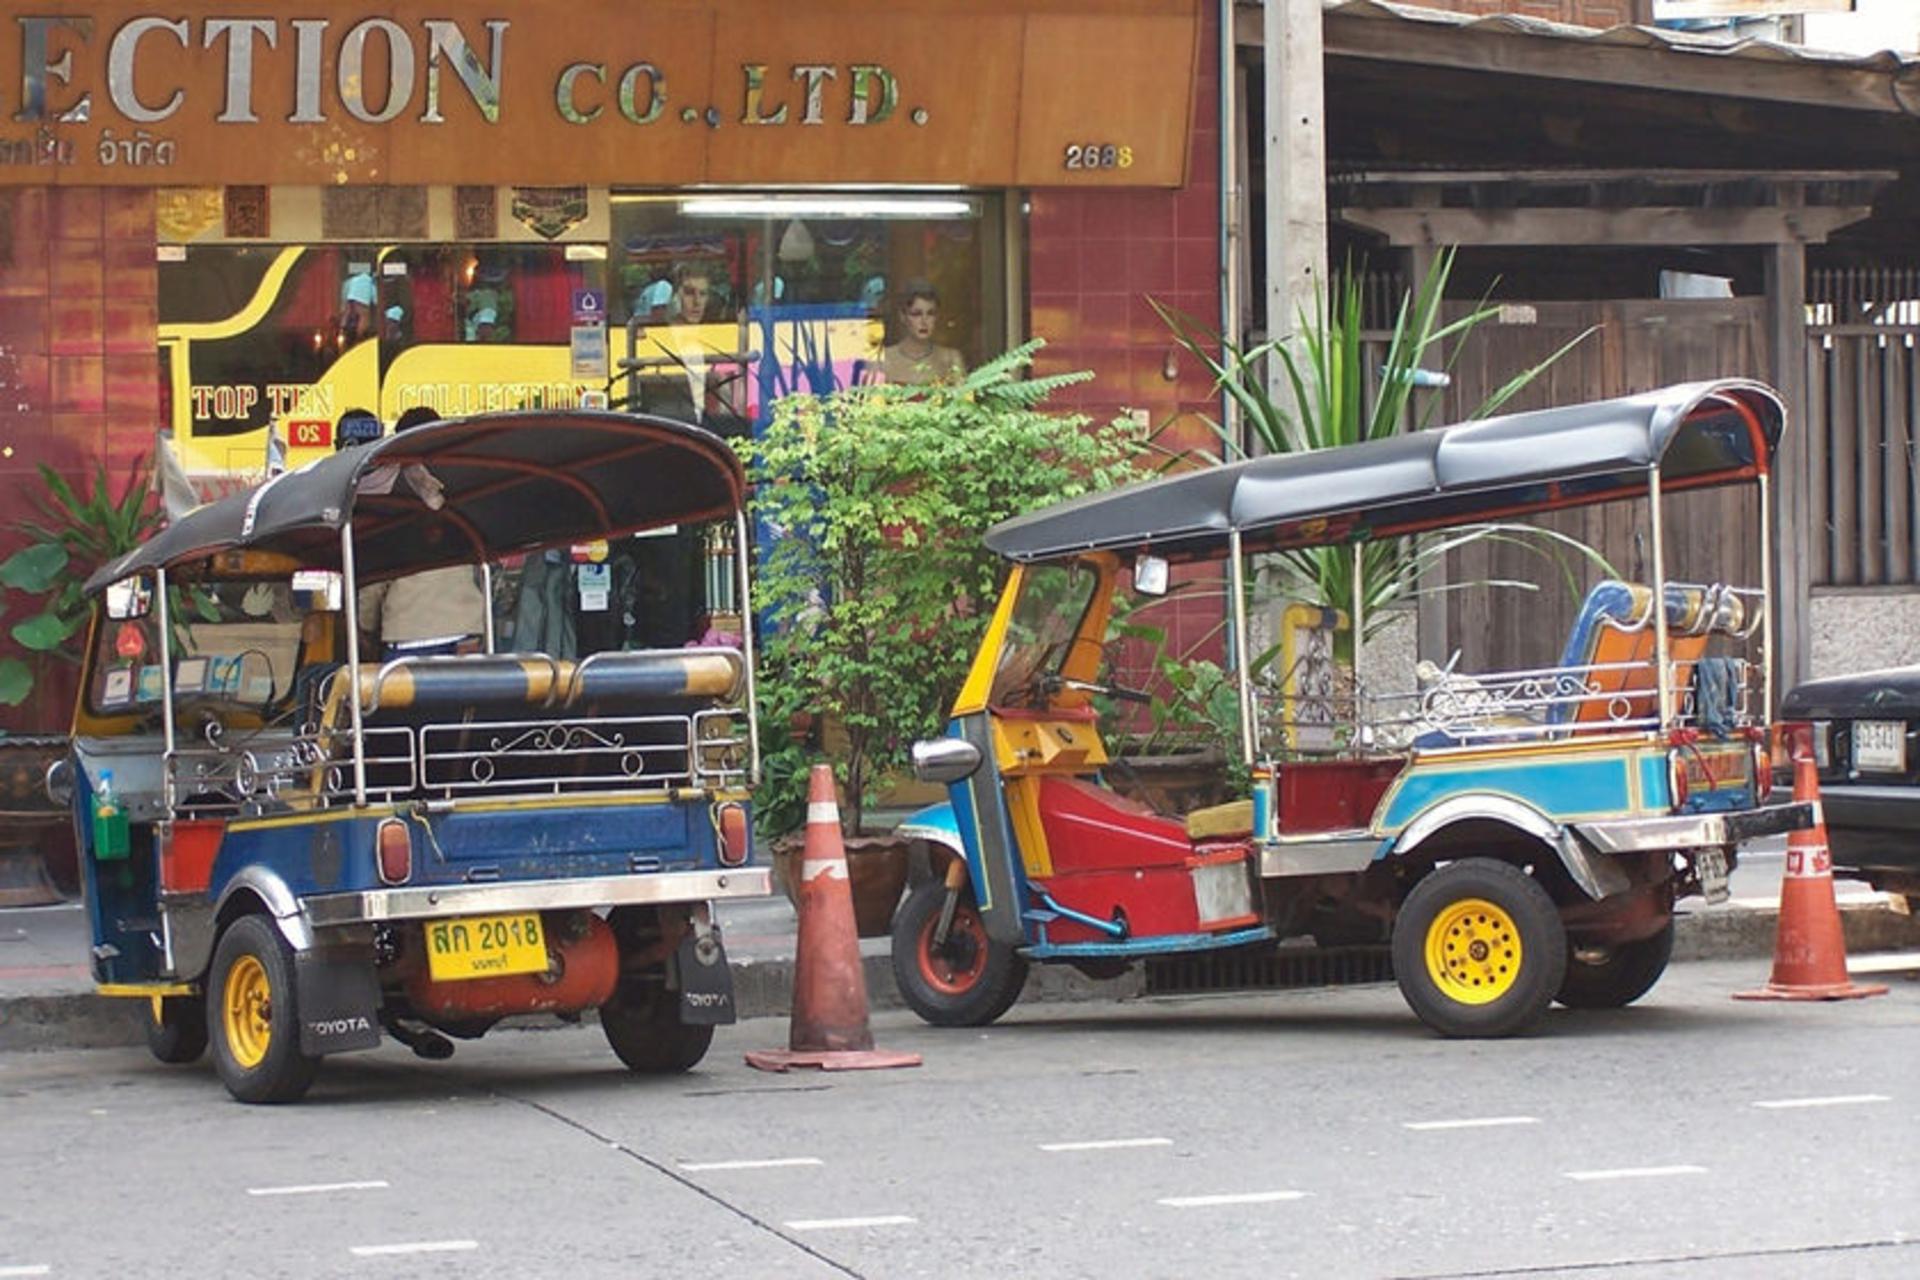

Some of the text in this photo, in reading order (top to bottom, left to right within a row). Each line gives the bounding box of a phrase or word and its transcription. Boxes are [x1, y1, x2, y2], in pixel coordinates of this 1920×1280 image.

[13, 17, 510, 124] ECTION
[192, 385, 258, 420] TOP
[267, 384, 334, 418] TEN
[478, 917, 539, 950] 2018
